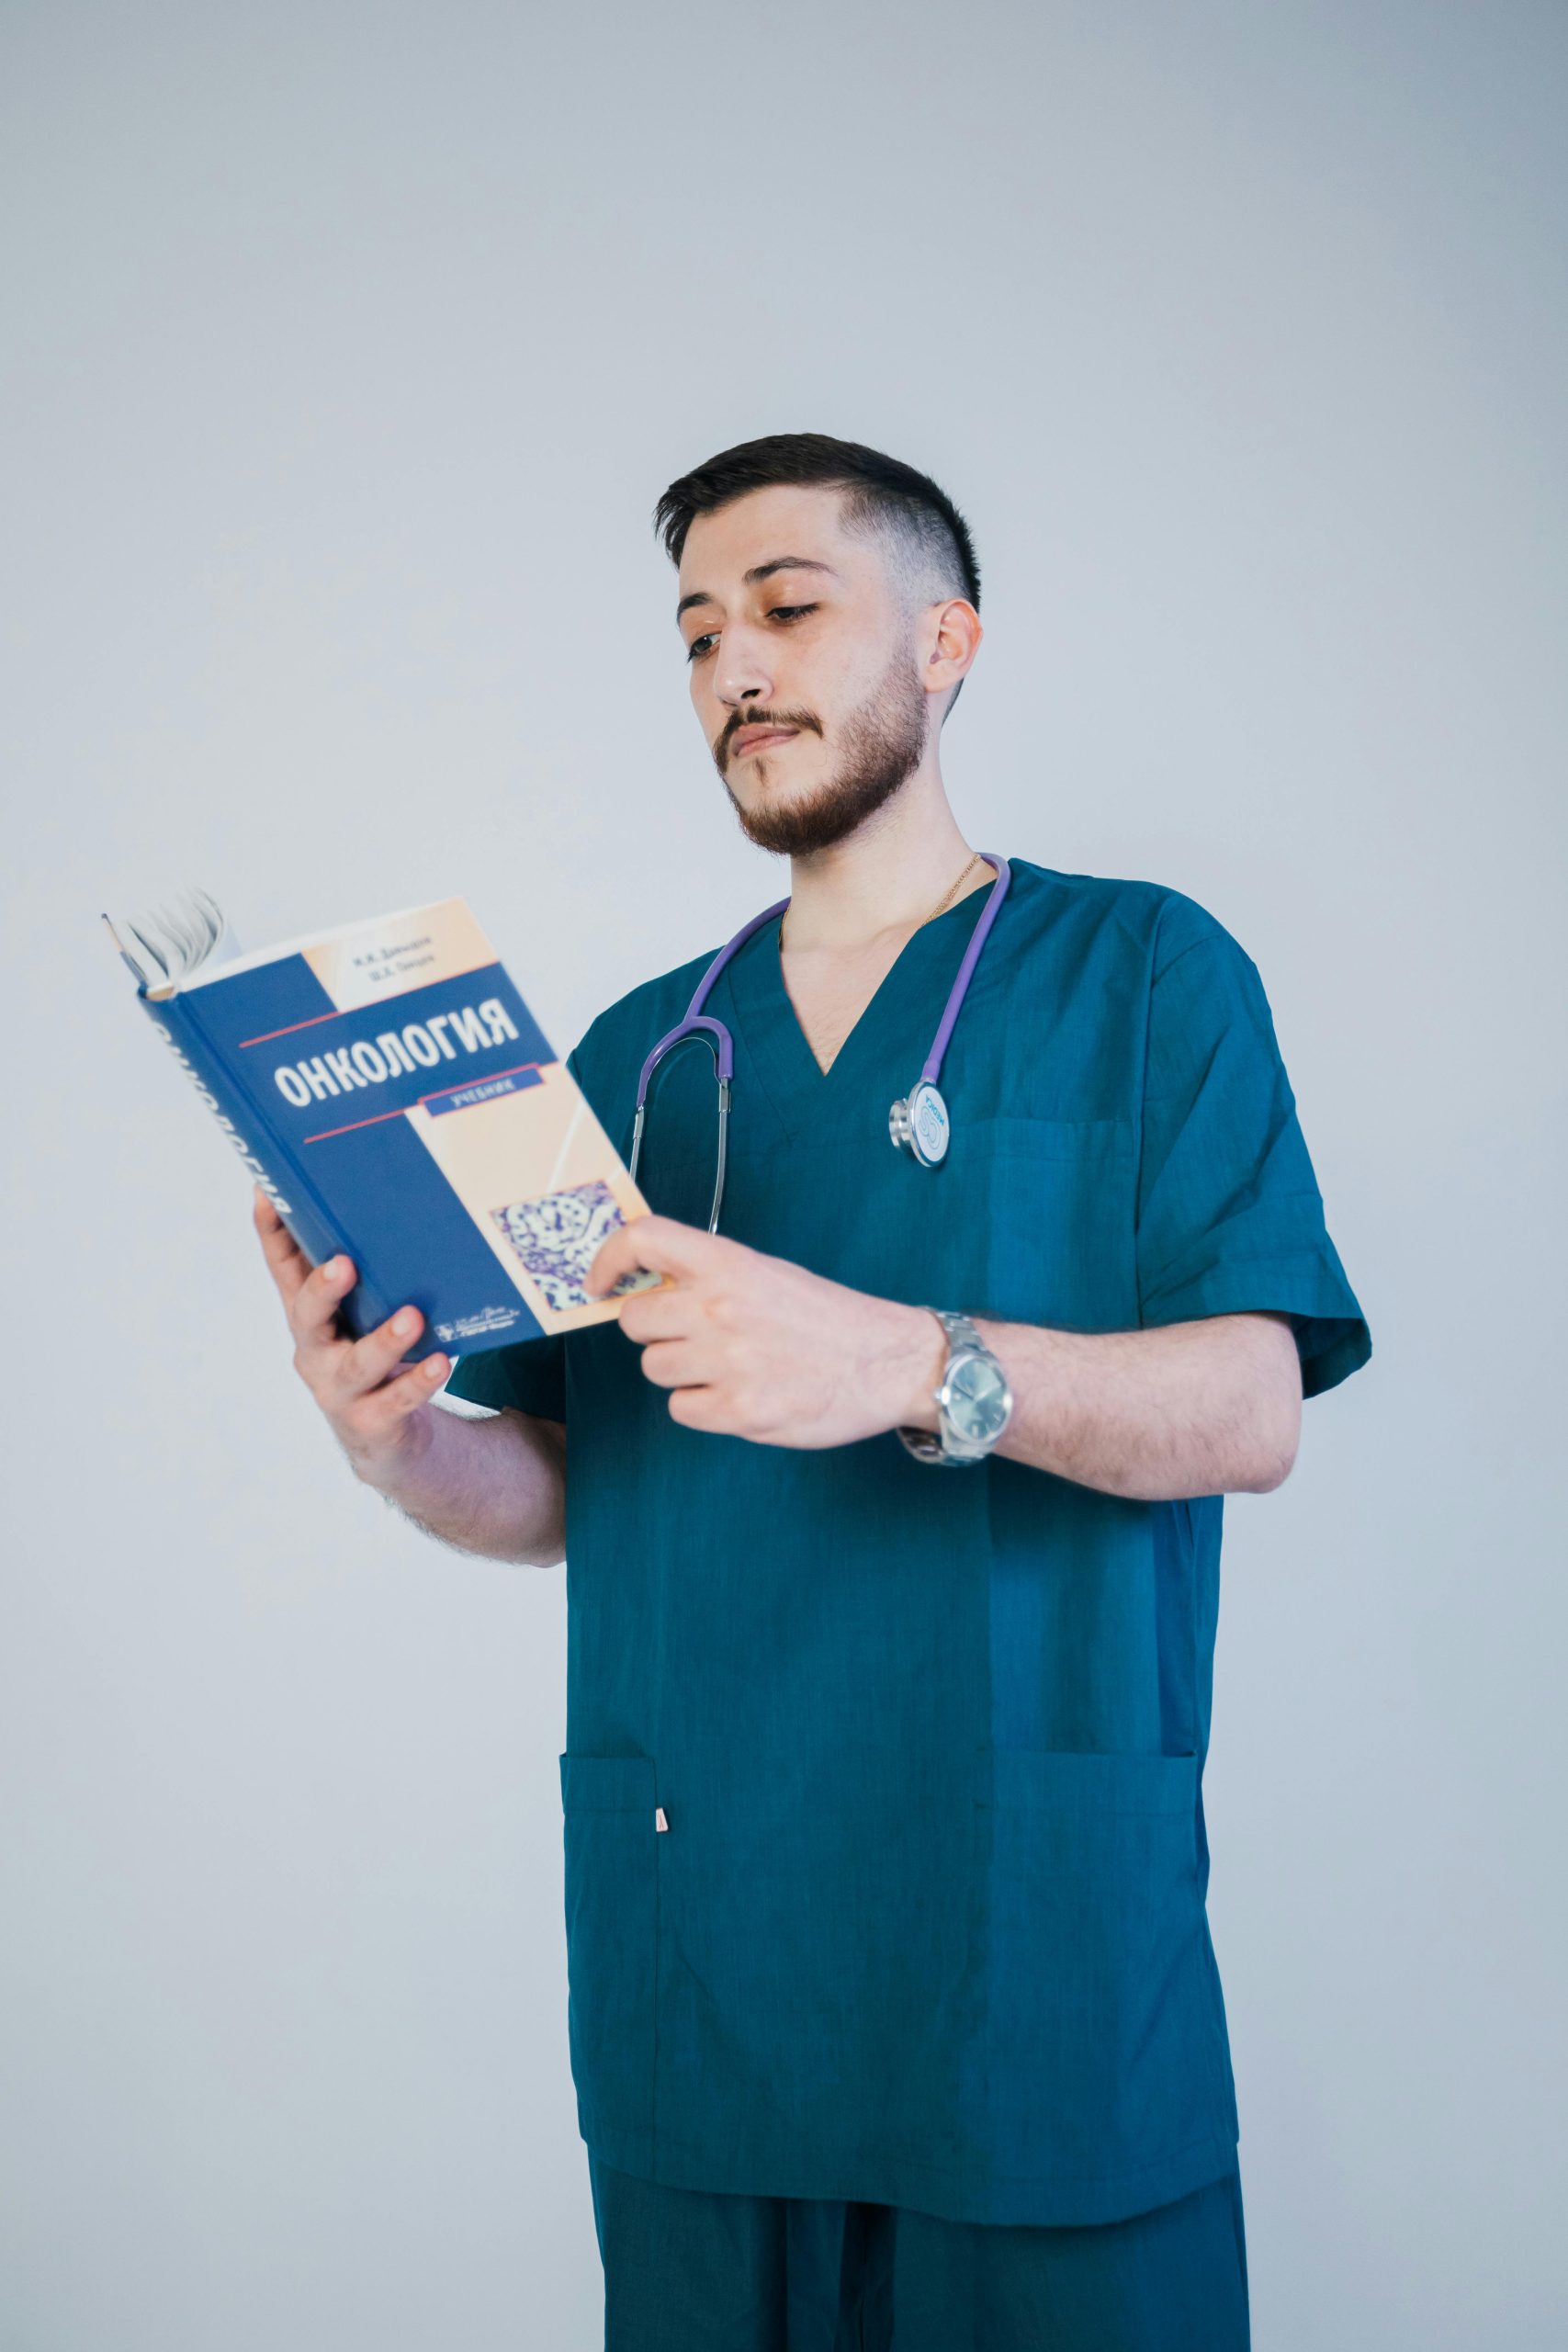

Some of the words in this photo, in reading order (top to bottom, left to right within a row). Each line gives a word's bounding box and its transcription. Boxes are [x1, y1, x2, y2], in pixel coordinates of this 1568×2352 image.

[274, 998, 520, 1107] ОНКОЛОГИЯ
[450, 1078, 516, 1108] УЧЕБНИК
[925, 1094, 945, 1127] MEDICA
